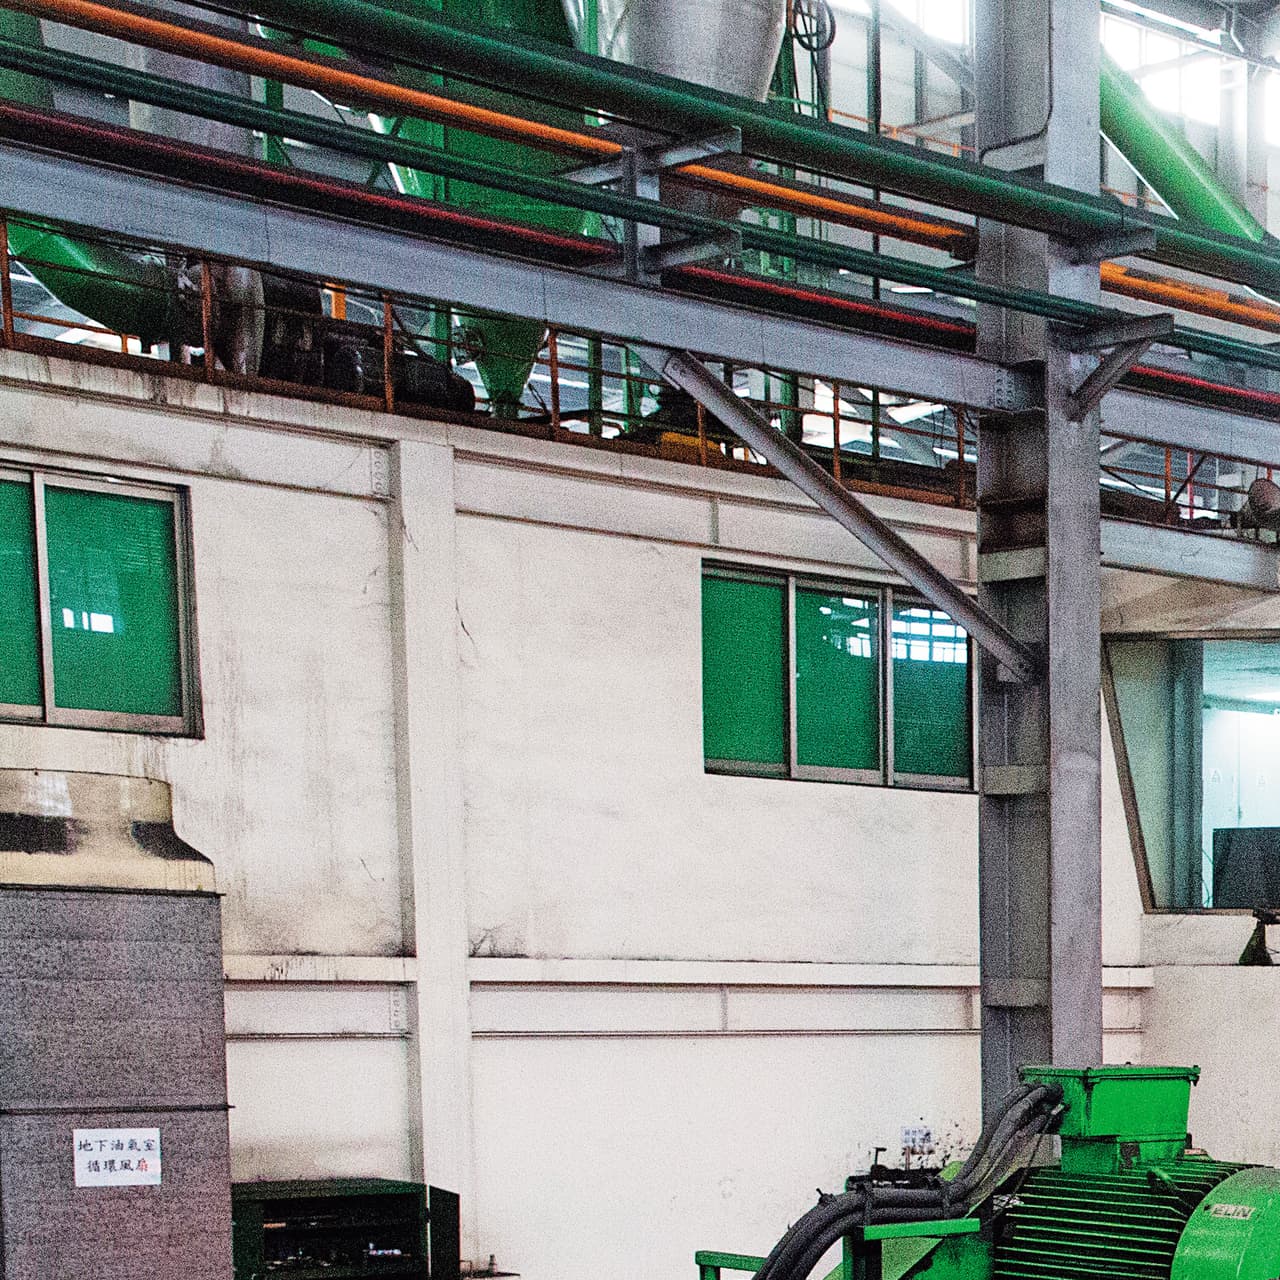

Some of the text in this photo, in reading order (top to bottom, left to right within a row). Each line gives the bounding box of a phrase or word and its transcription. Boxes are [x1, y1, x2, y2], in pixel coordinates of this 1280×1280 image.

[78, 1139, 155, 1151] 地下油氣室
[86, 1158, 148, 1172] 循環風扇
